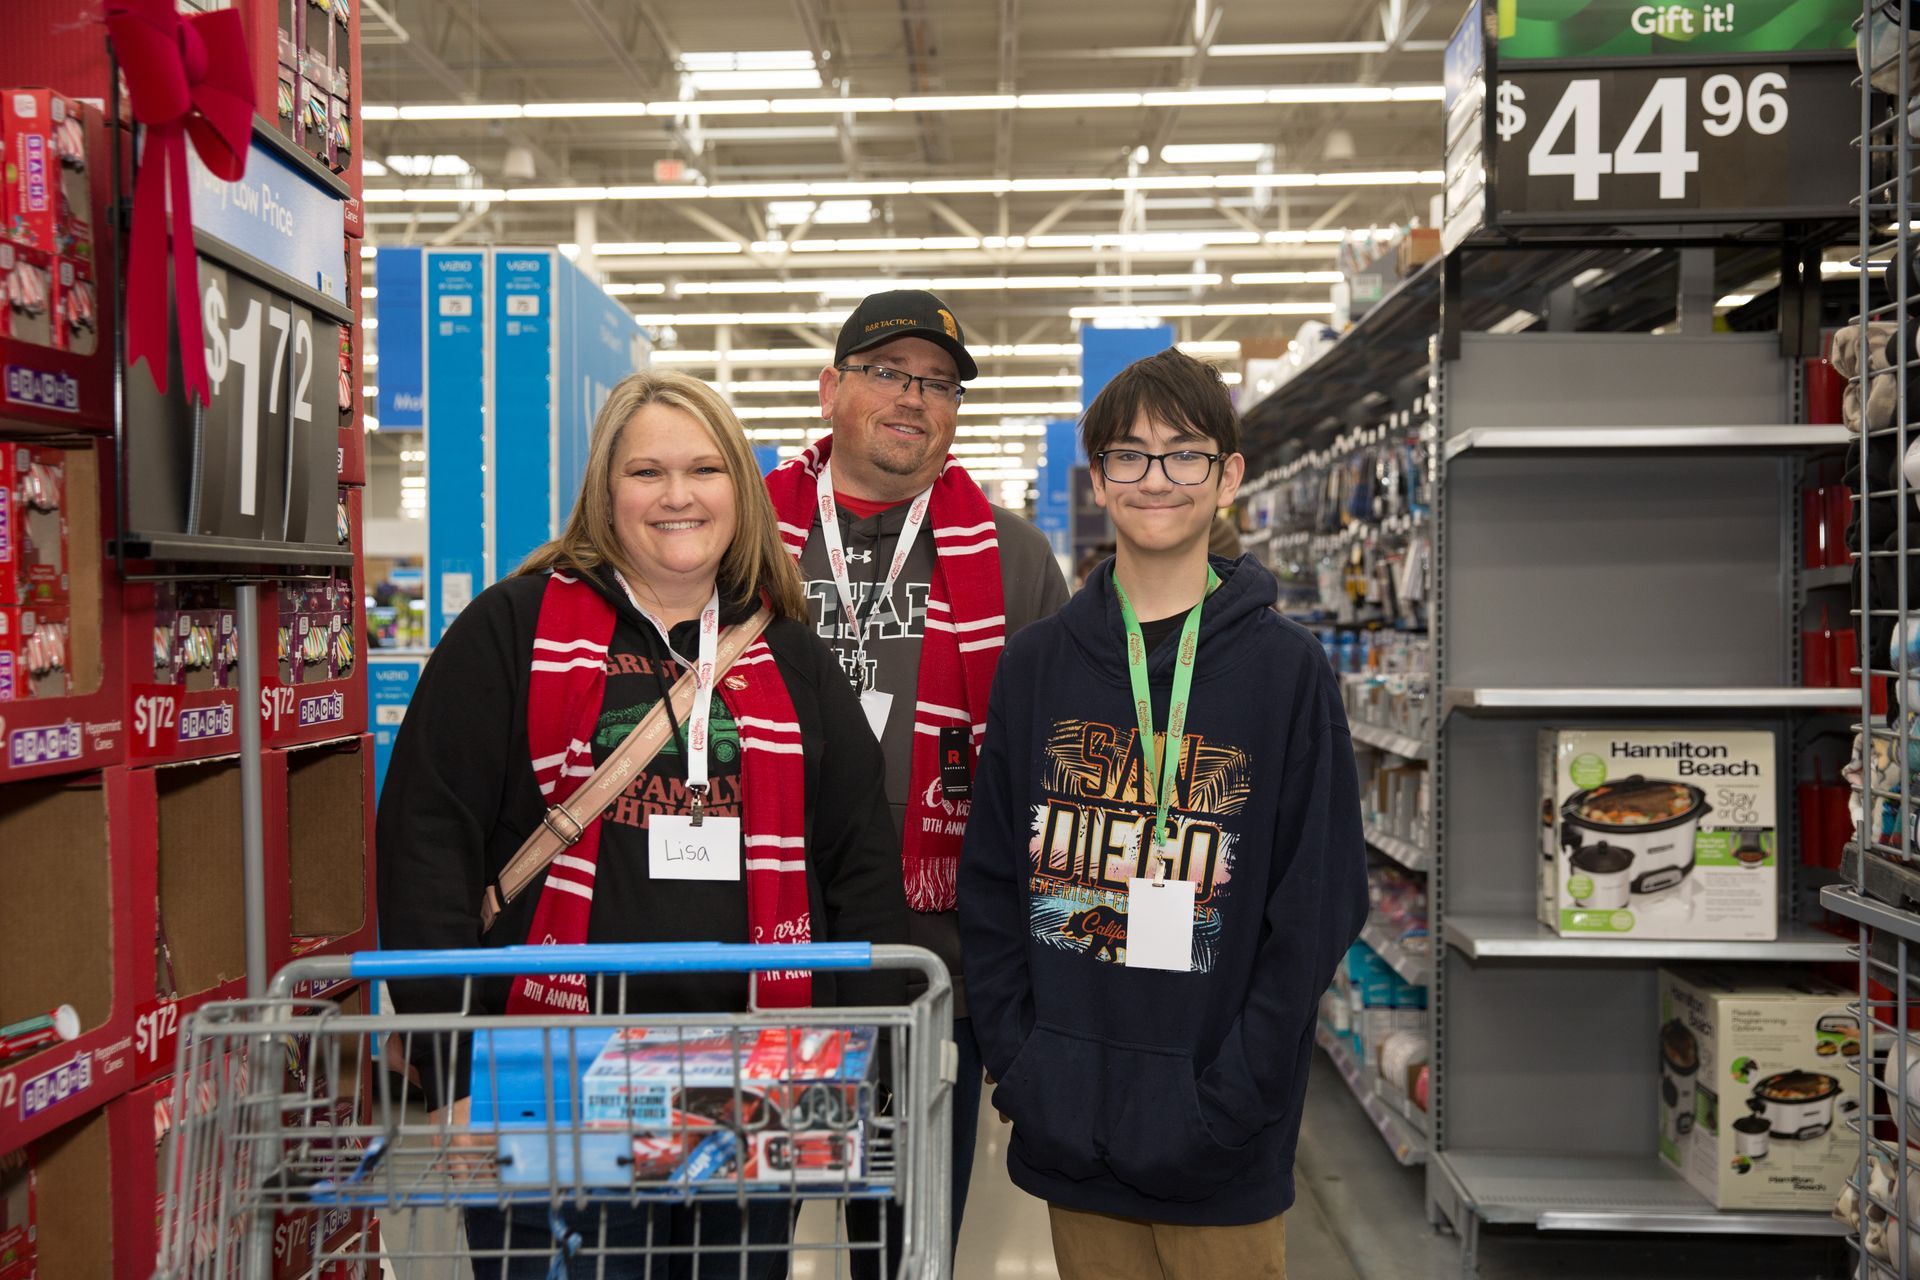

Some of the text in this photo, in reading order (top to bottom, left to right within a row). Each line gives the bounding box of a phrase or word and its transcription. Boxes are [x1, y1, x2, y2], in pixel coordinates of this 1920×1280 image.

[1630, 4, 1735, 35] Gift it!
[233, 181, 259, 217] Low
[262, 183, 294, 237] Price
[438, 260, 472, 271] VIZIO
[506, 260, 540, 271] VIZIO
[880, 318, 919, 328] TACTICAL
[1611, 741, 1728, 758] Hamilton
[1078, 721, 1204, 811] SAN
[1678, 760, 1760, 776] Beach
[1717, 788, 1756, 810] Stay
[922, 817, 943, 833] 10TH
[1731, 807, 1760, 824] Go
[665, 839, 710, 862] Lisa
[1034, 799, 1221, 904] DIEGO
[523, 978, 544, 1002] 10TH
